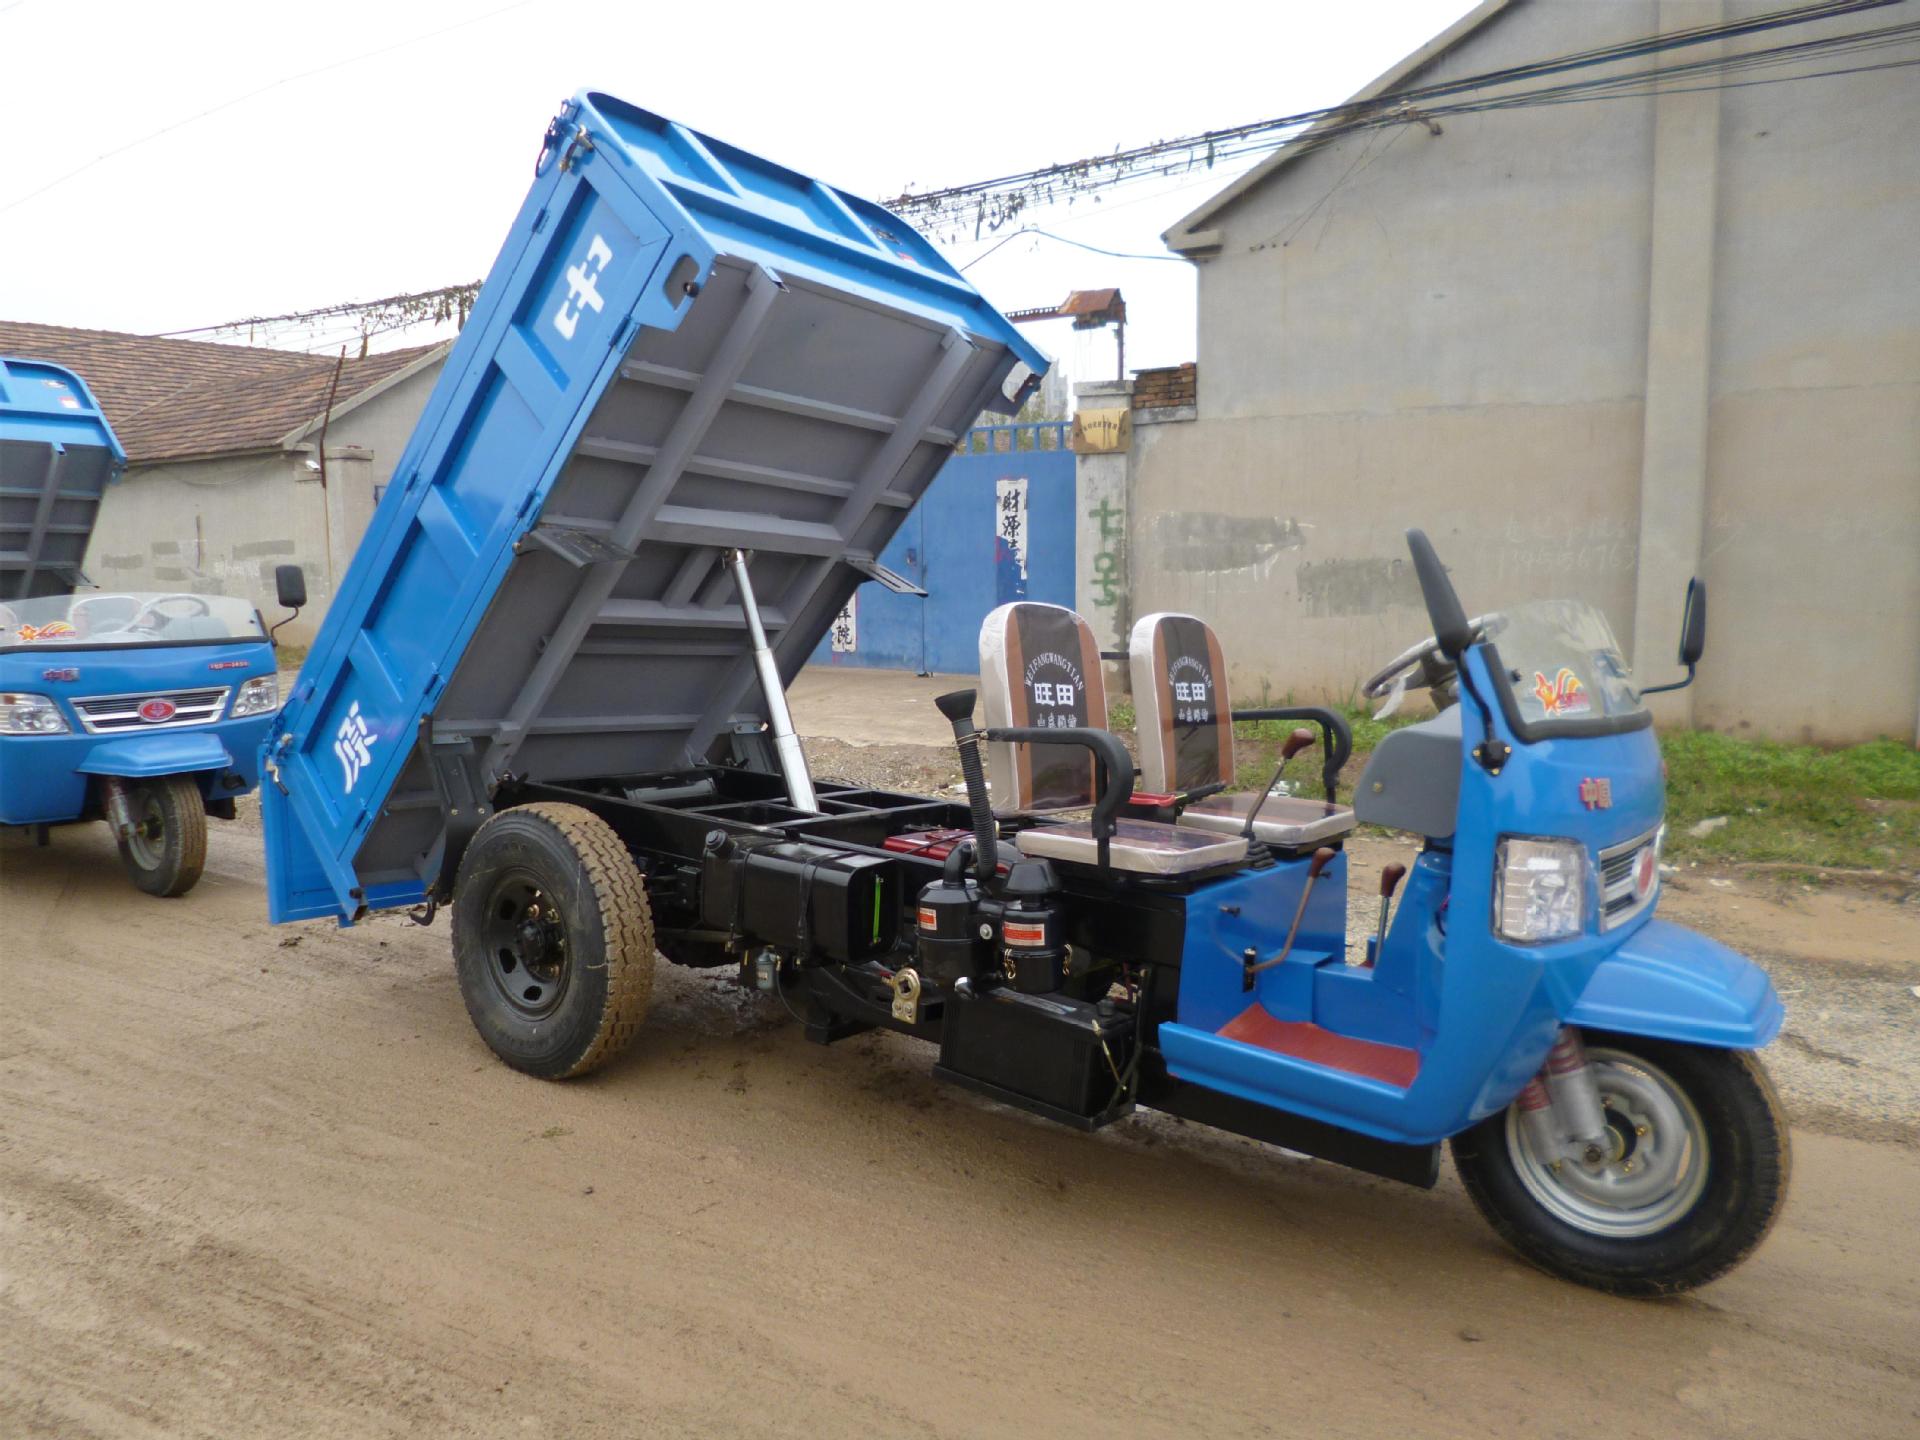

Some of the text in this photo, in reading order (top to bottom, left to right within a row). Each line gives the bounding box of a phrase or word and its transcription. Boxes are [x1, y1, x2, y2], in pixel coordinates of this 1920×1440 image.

[553, 233, 612, 340] 中
[1034, 682, 1074, 707] 旺田
[1175, 681, 1206, 702] 旺田
